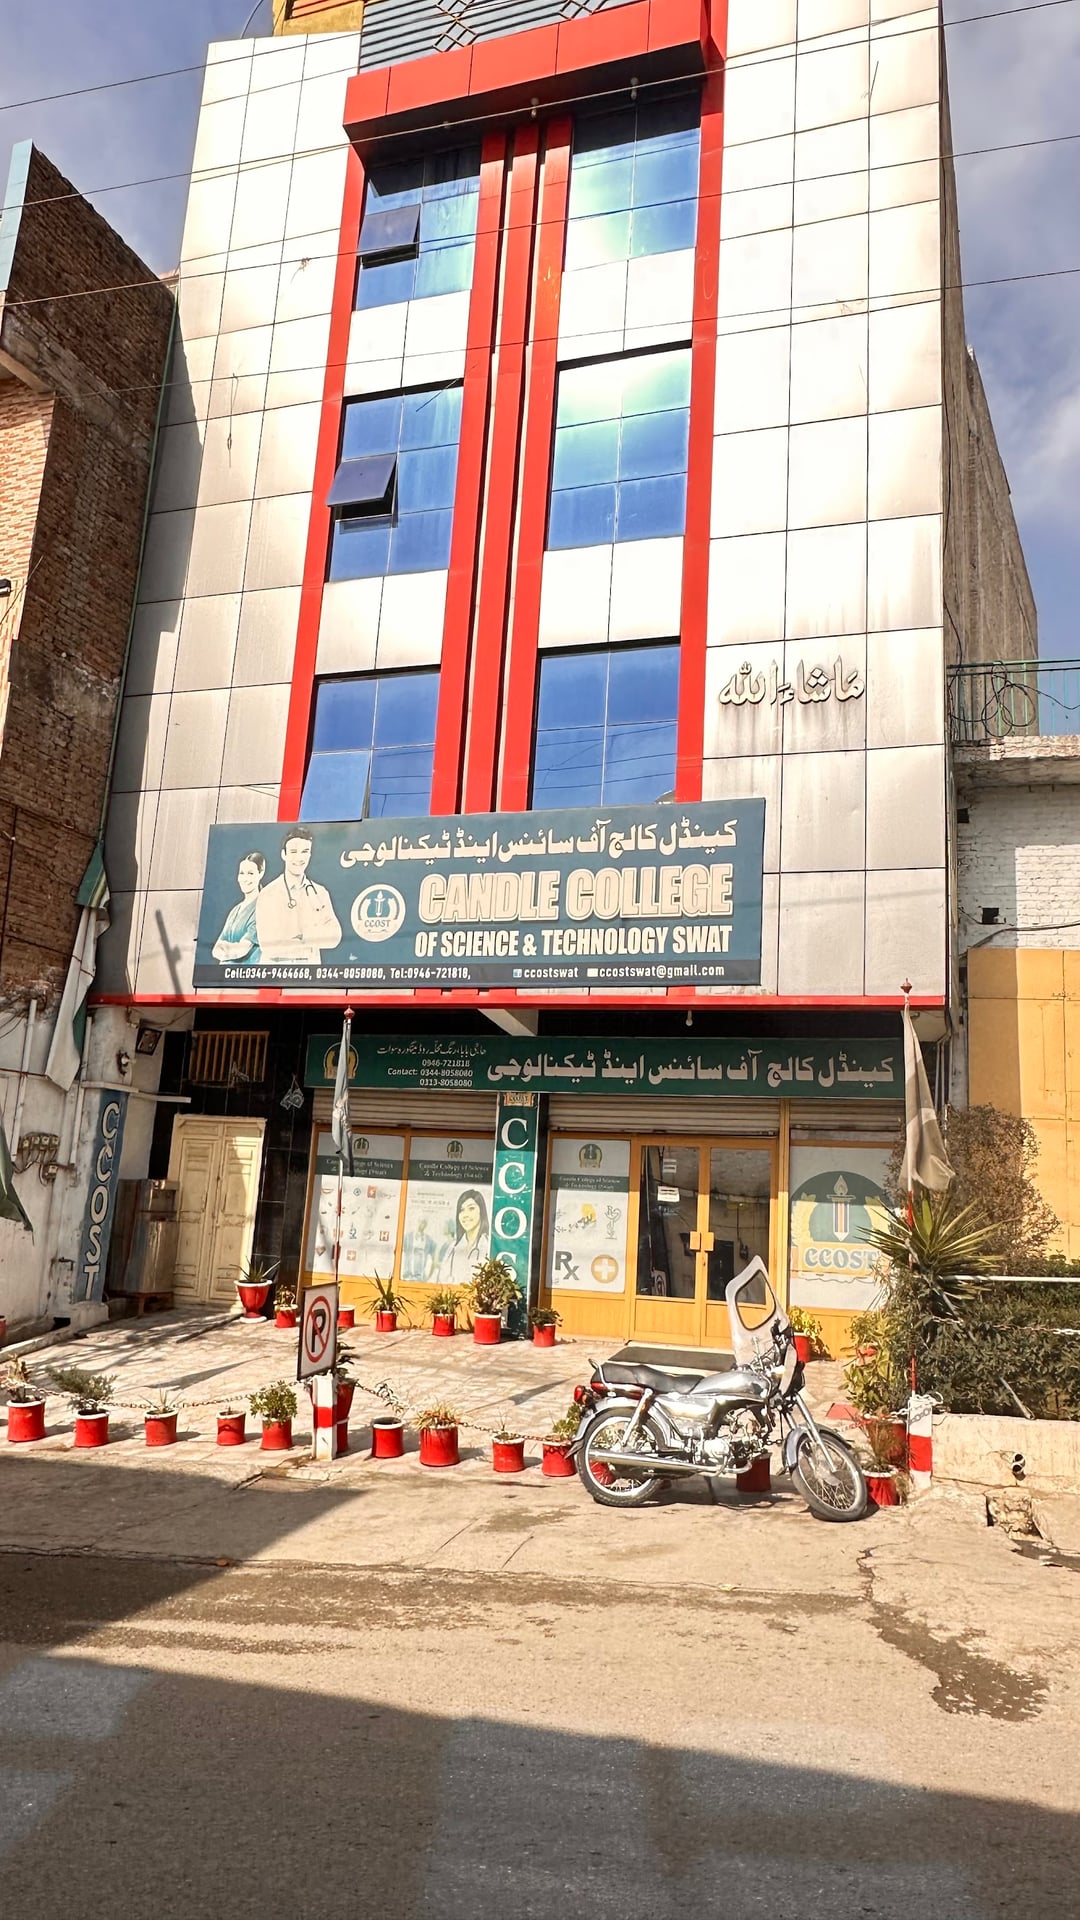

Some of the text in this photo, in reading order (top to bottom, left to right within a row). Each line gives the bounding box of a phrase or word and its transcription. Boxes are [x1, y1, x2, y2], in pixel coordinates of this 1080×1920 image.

[340, 816, 738, 868] کینڈل کالج آف سائنس اینڈ ٹیکنالوجی
[418, 863, 735, 923] CANDLE COLLEGE
[364, 919, 391, 928] CCOST
[414, 925, 733, 958] OF SCIENCE & TECHNOLOGY SWAT
[524, 966, 578, 978] ccostswat
[599, 964, 725, 979] ccostswat@gmail.com
[387, 1067, 418, 1075] Contact:
[487, 1048, 894, 1088] کینڈل کالج آف سائنس اینڈ ٹیکنالوجی
[83, 1102, 120, 1300] CCOST
[555, 1251, 580, 1281] Rx
[804, 1247, 878, 1270] CCOST
[311, 1308, 327, 1353] P
